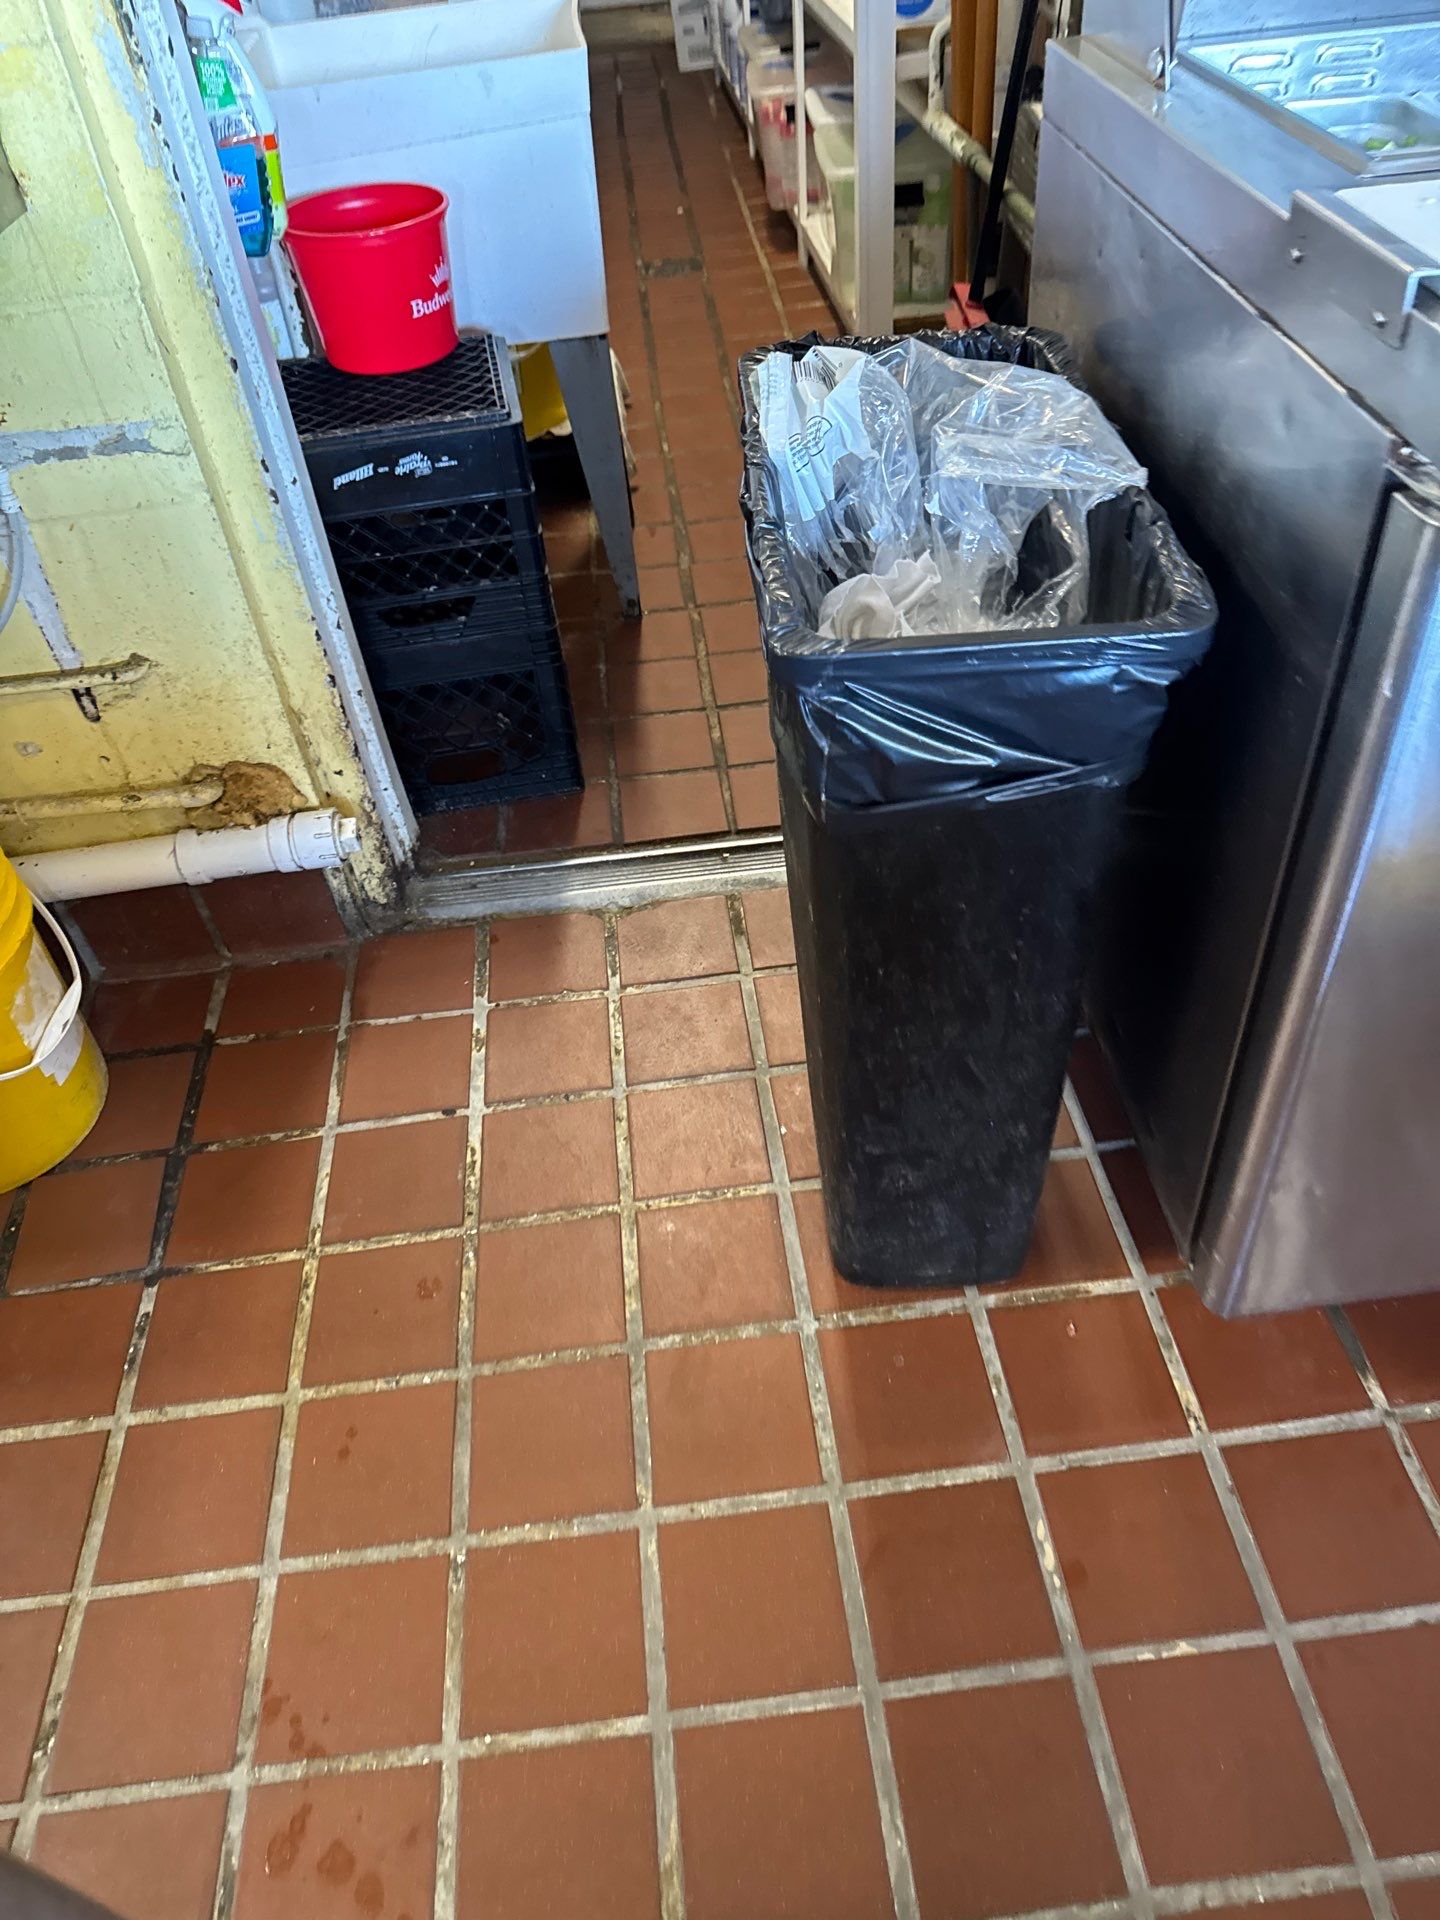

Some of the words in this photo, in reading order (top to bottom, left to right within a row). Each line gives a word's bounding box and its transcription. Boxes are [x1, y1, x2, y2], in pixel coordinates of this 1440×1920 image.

[199, 61, 225, 78] 100%
[410, 291, 451, 319] Budw
[333, 463, 374, 490] Hiland
